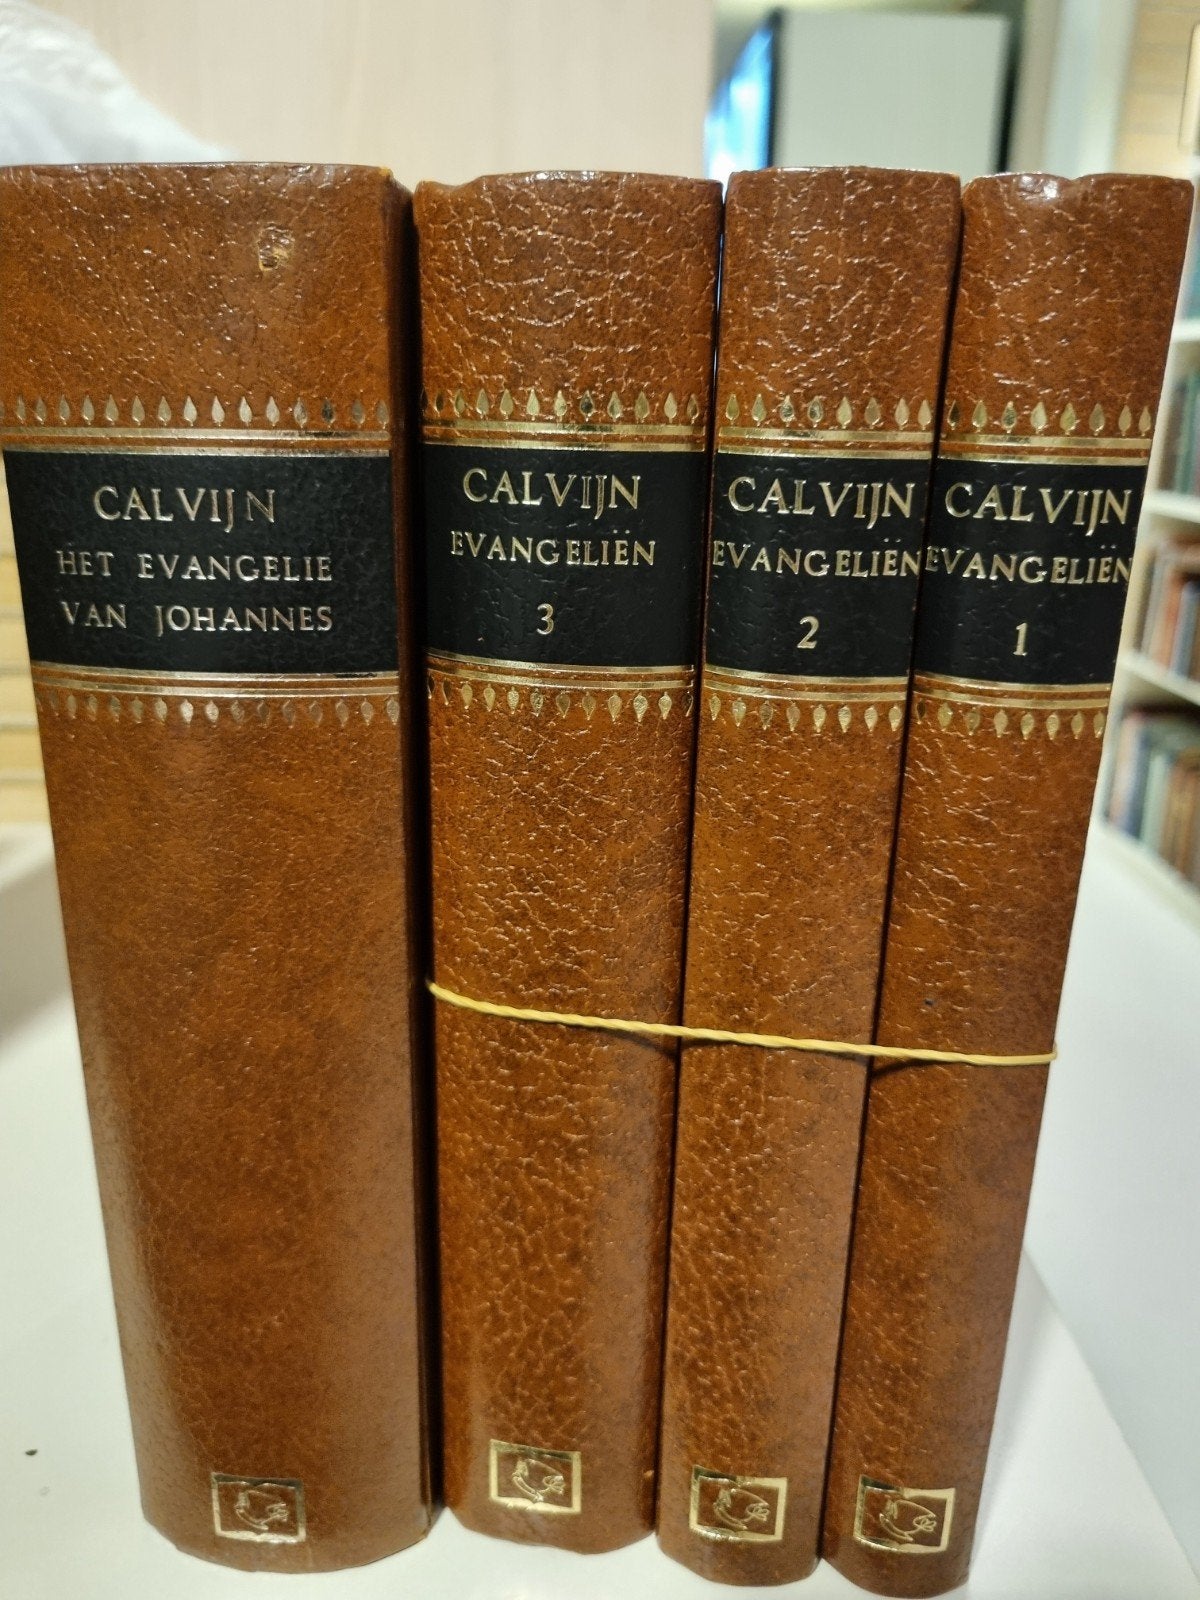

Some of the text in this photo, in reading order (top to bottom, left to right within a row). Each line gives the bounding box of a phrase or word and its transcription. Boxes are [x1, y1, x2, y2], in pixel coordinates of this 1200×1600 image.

[93, 484, 276, 533] CALVIJN
[462, 467, 642, 520] CALVIJN
[727, 475, 916, 530] CALVIJN
[944, 481, 1133, 537] CALVIJN
[56, 549, 333, 582] HET EVANGELIE
[450, 528, 656, 566] EVANGELIËN
[712, 537, 921, 578] EVANGELIËN
[924, 544, 1133, 584] EVANGELIËN
[60, 600, 333, 637] VAN JOHANNES
[536, 602, 555, 636] 3
[796, 615, 820, 650] 2
[1012, 621, 1029, 657] 1
